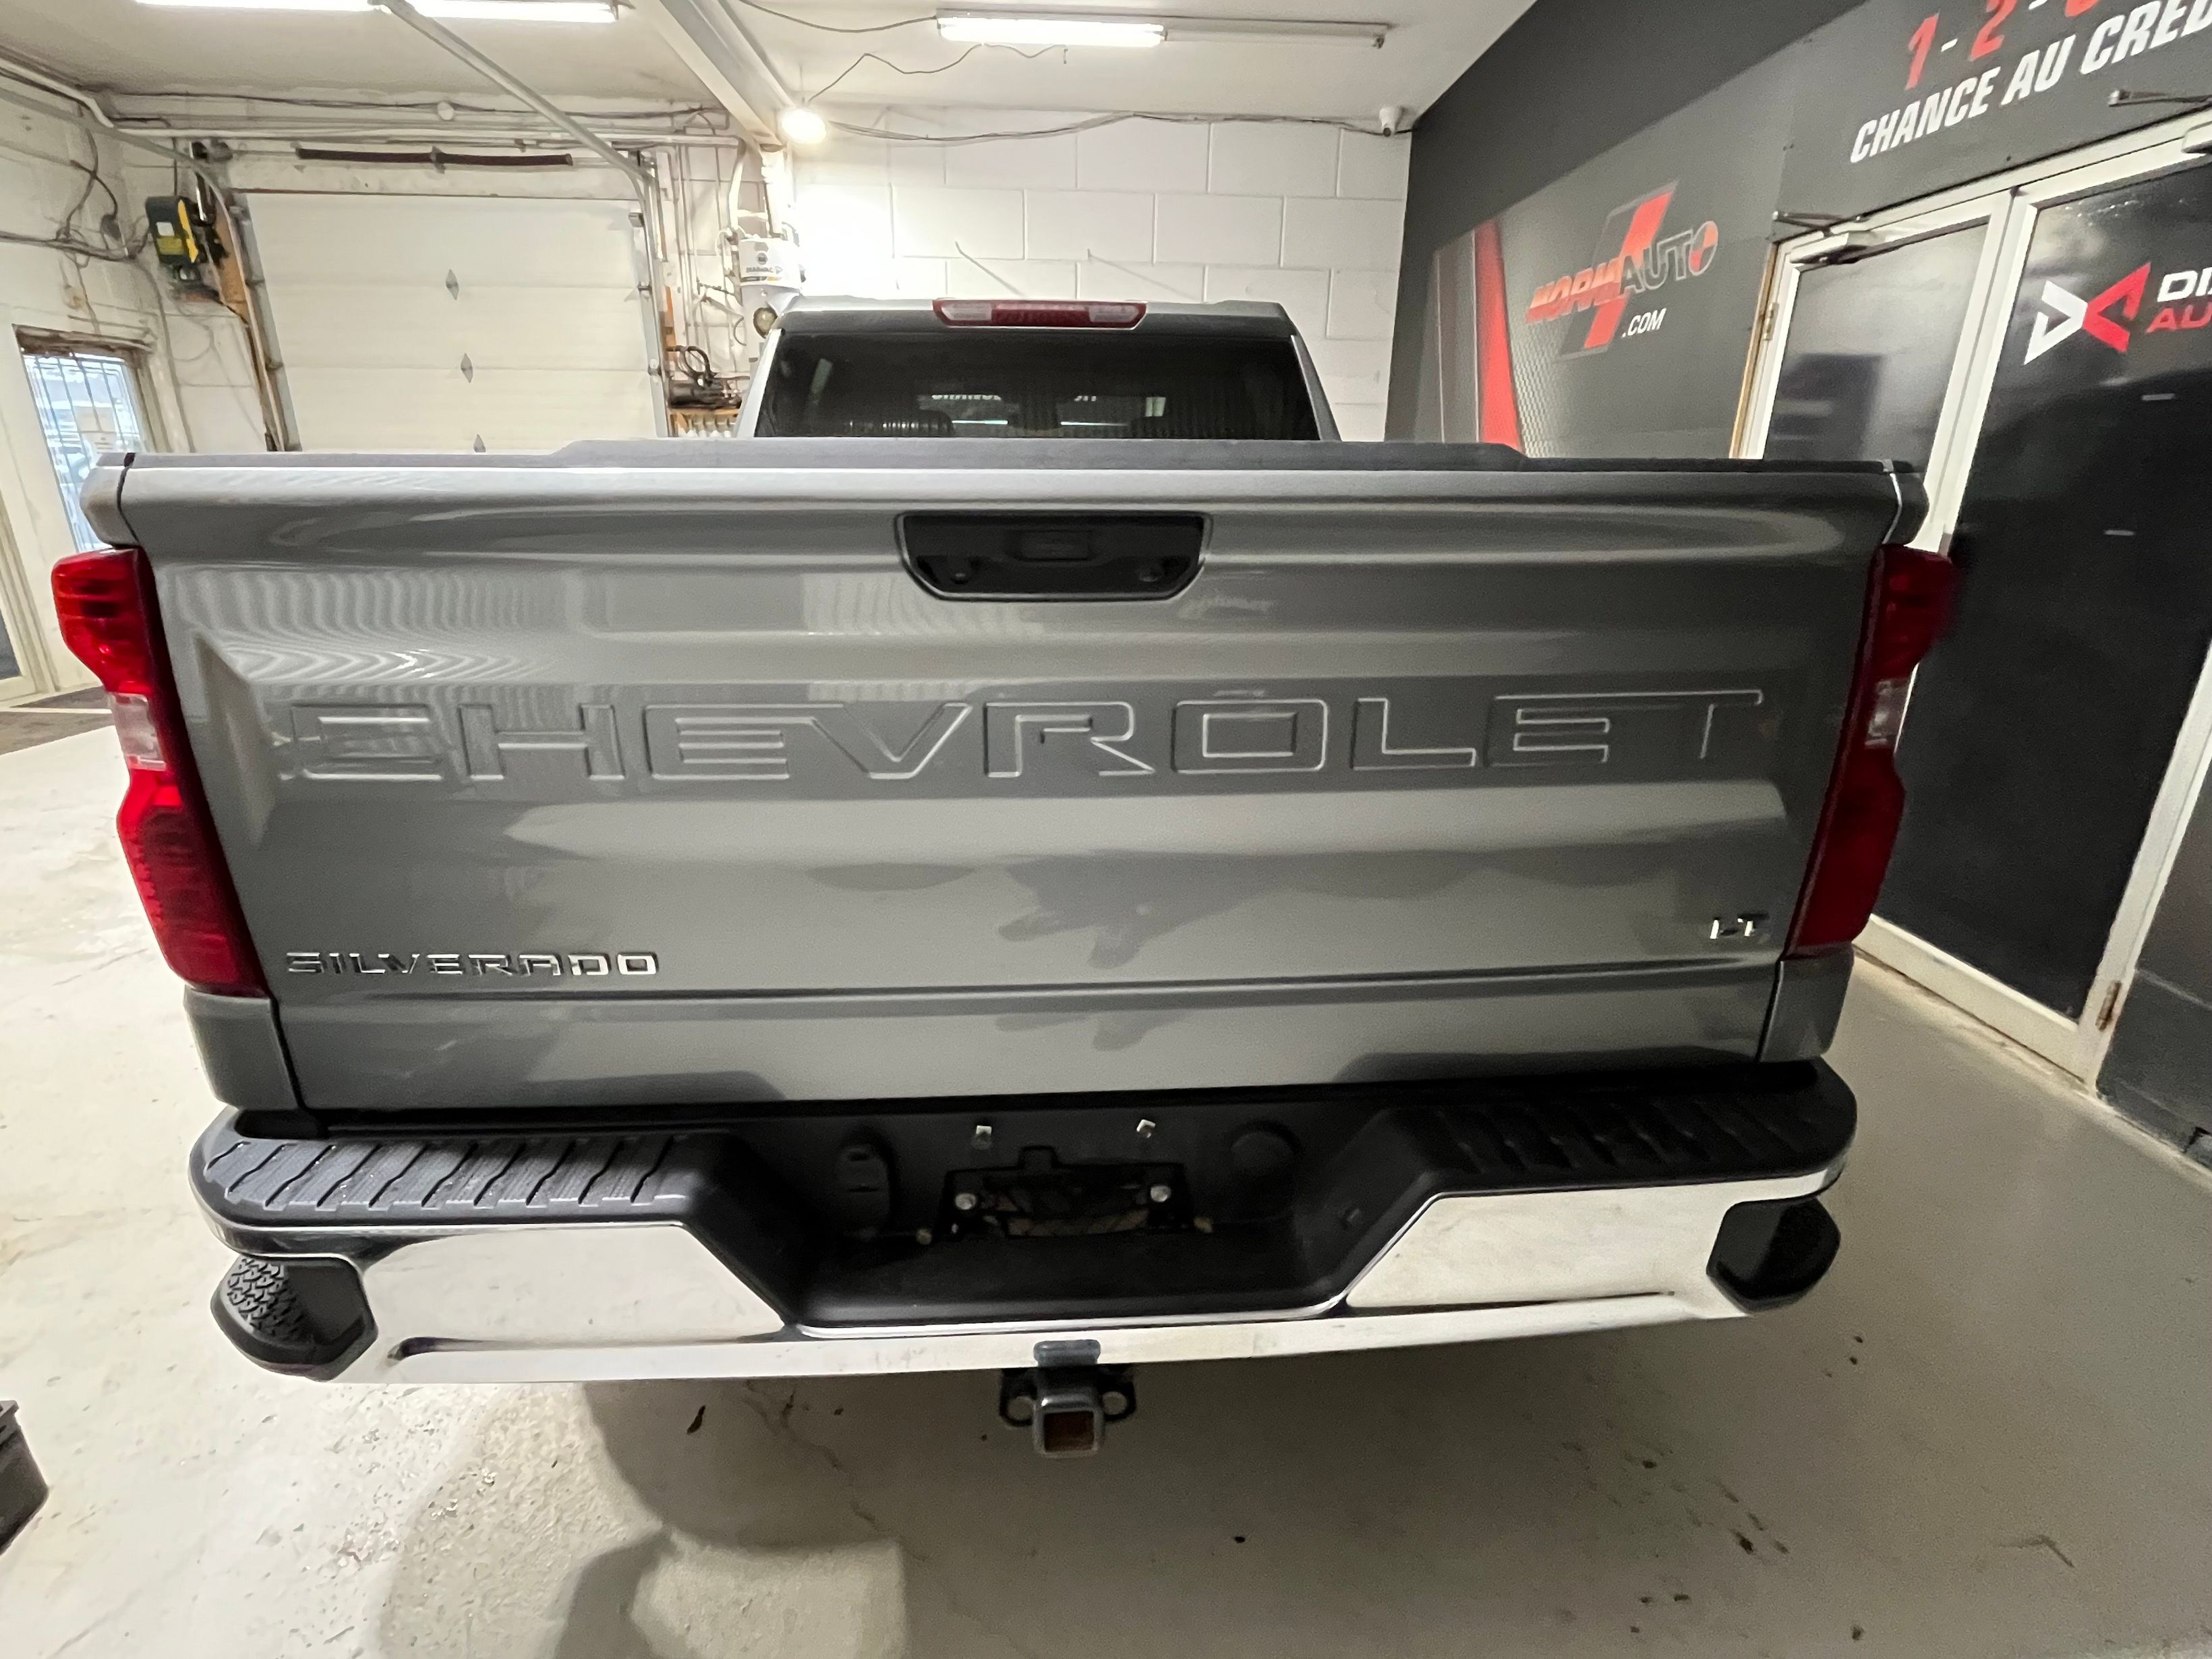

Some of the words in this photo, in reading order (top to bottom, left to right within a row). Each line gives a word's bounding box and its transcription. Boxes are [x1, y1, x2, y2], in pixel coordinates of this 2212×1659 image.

[1850, 67, 2002, 163] CHANCE
[2001, 34, 2076, 106] AU
[2157, 267, 2212, 302] DI
[1621, 307, 1667, 338] .COM
[285, 689, 1764, 782] CHEVROLET
[286, 951, 658, 977] SILVERADO
